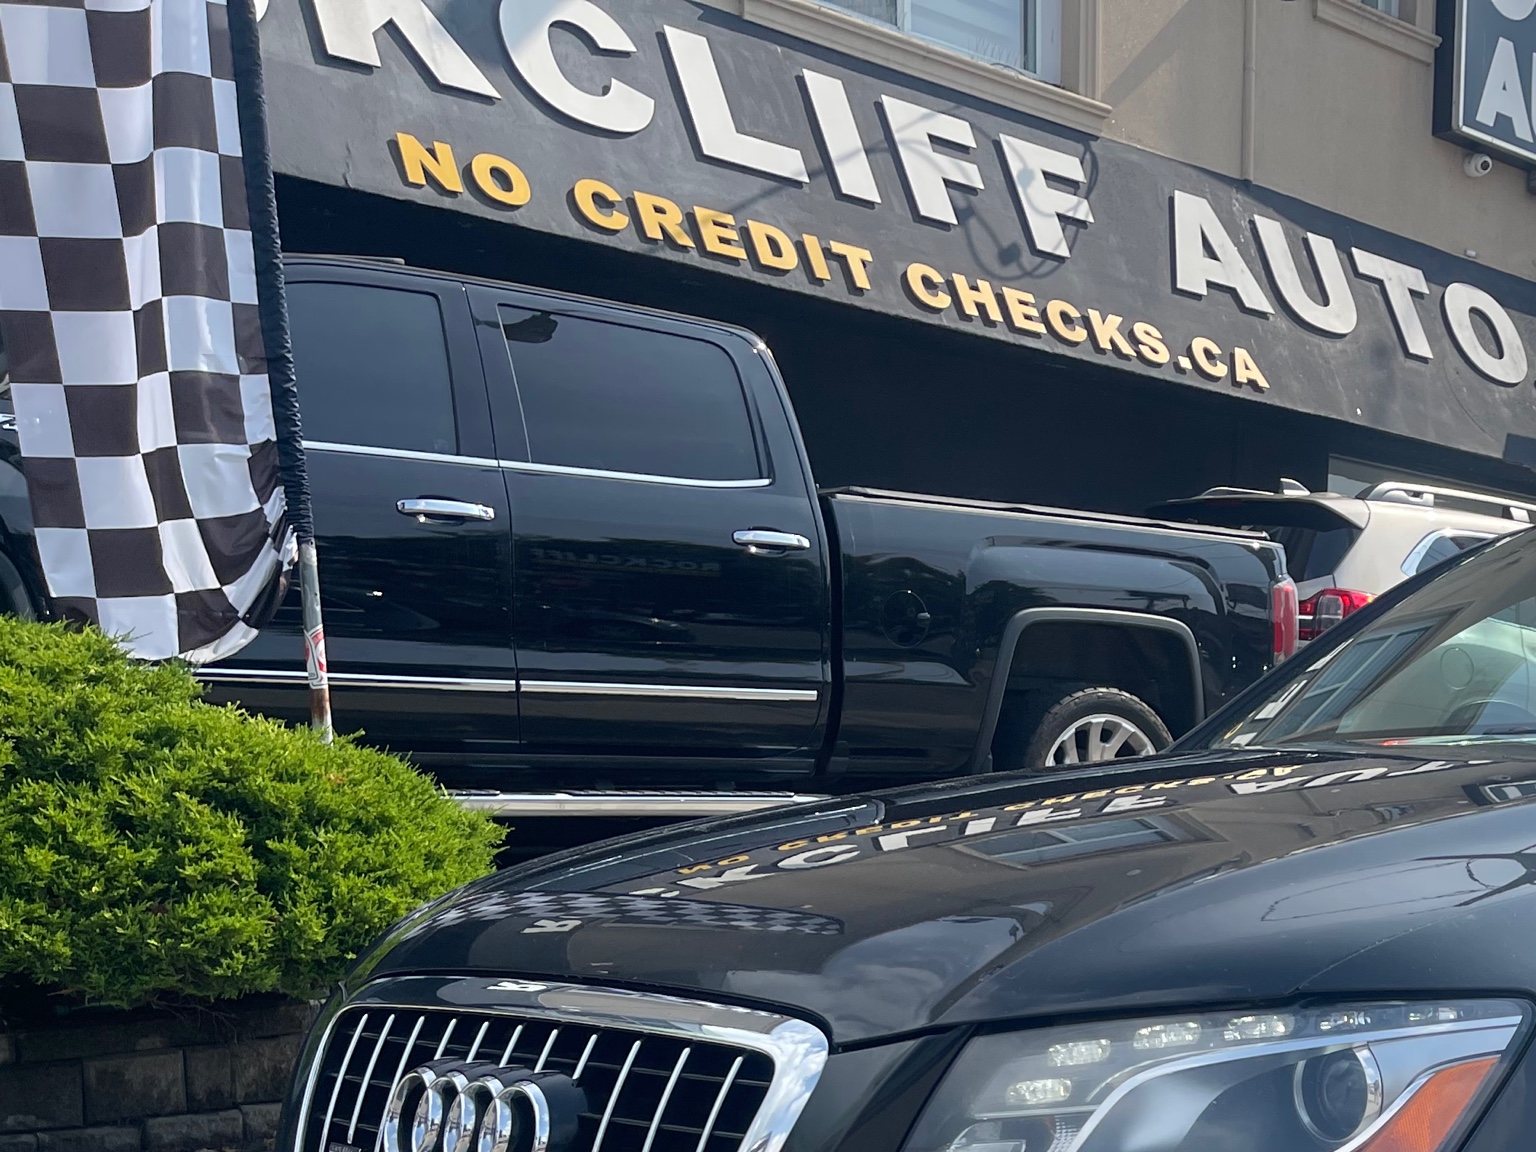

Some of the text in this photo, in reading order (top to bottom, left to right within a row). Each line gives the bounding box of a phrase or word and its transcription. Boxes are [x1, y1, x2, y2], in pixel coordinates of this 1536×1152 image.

[396, 132, 1270, 390] NO CREDIT CHECKS.CA
[1173, 190, 1528, 386] AUTO
